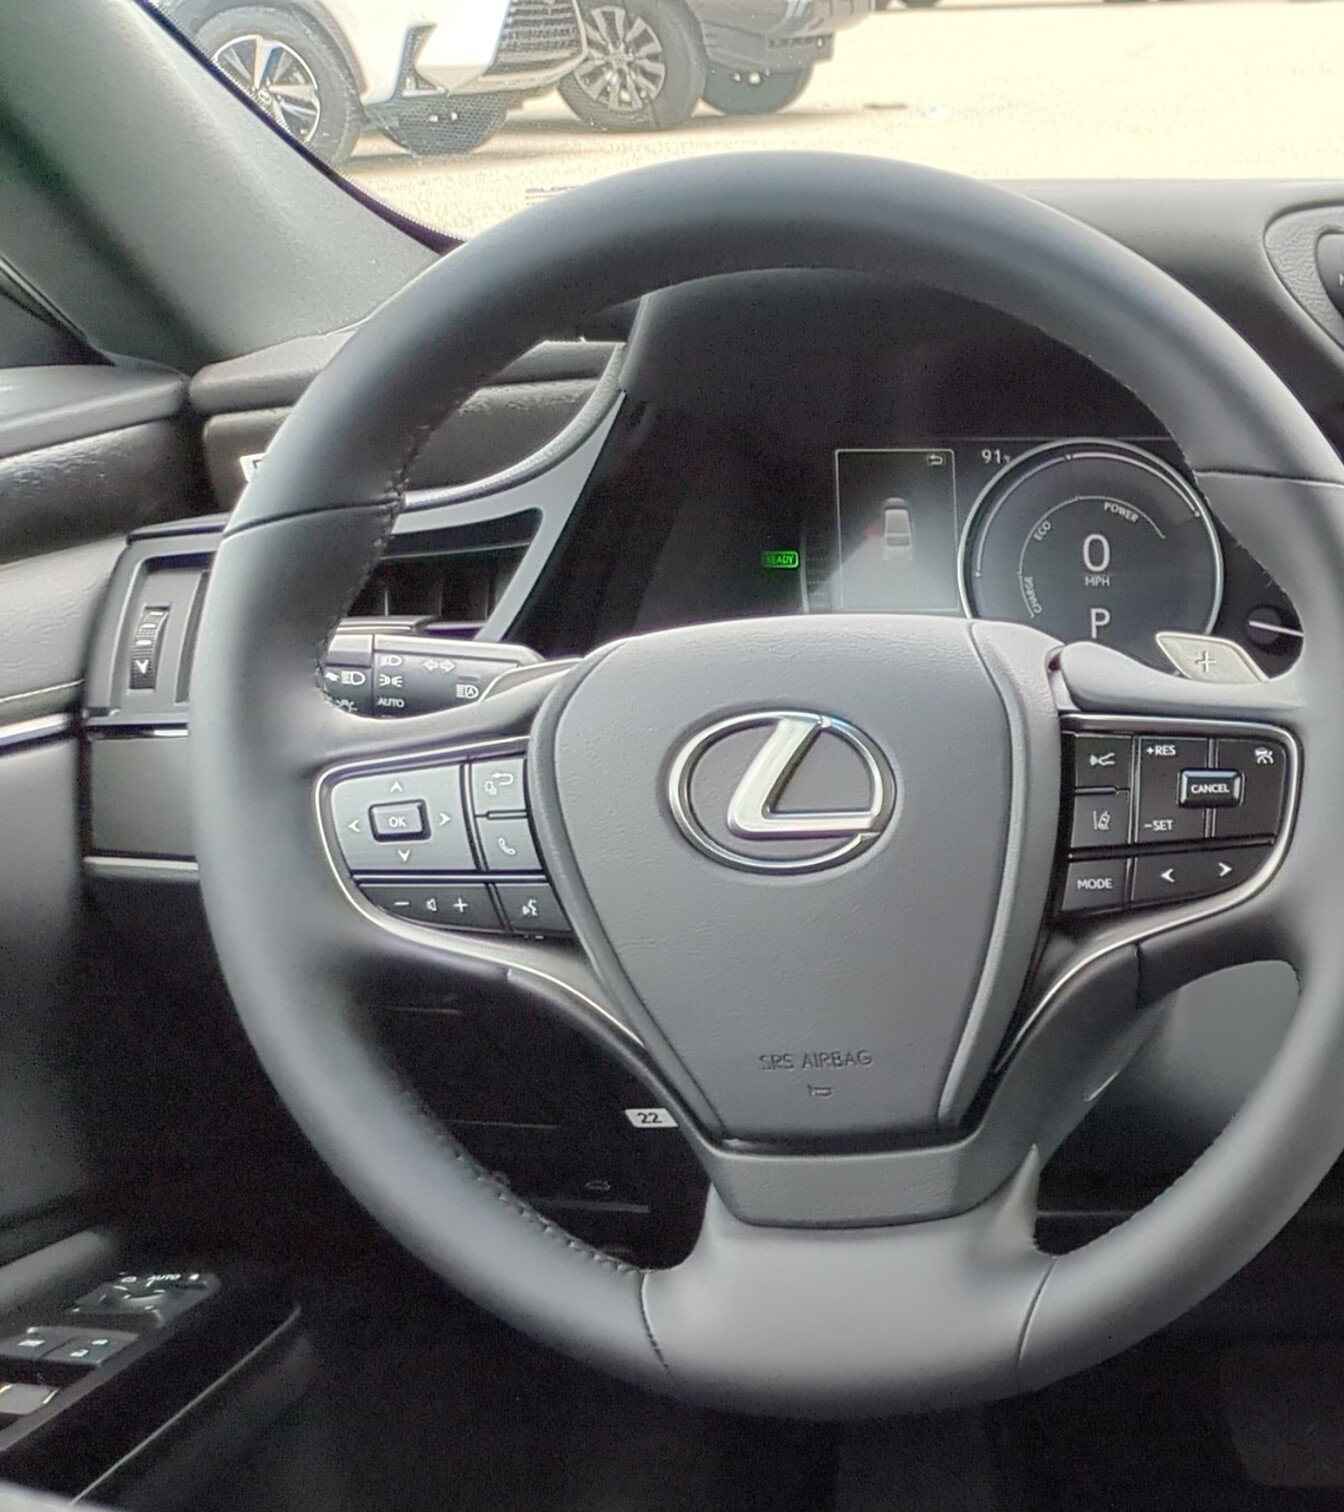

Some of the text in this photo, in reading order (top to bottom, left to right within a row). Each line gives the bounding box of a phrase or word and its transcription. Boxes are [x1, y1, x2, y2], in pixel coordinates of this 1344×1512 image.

[1103, 501, 1140, 524] POWER
[1034, 520, 1051, 542] ECO
[1083, 534, 1111, 572] 0
[1084, 576, 1111, 587] MPH
[1090, 607, 1111, 639] P
[377, 697, 405, 707] AUTO
[1190, 783, 1230, 794] CANCEL
[388, 815, 406, 828] OK
[1077, 878, 1113, 889] MODE
[759, 1050, 873, 1070] SRS AIRBAG
[637, 1112, 663, 1124] 22
